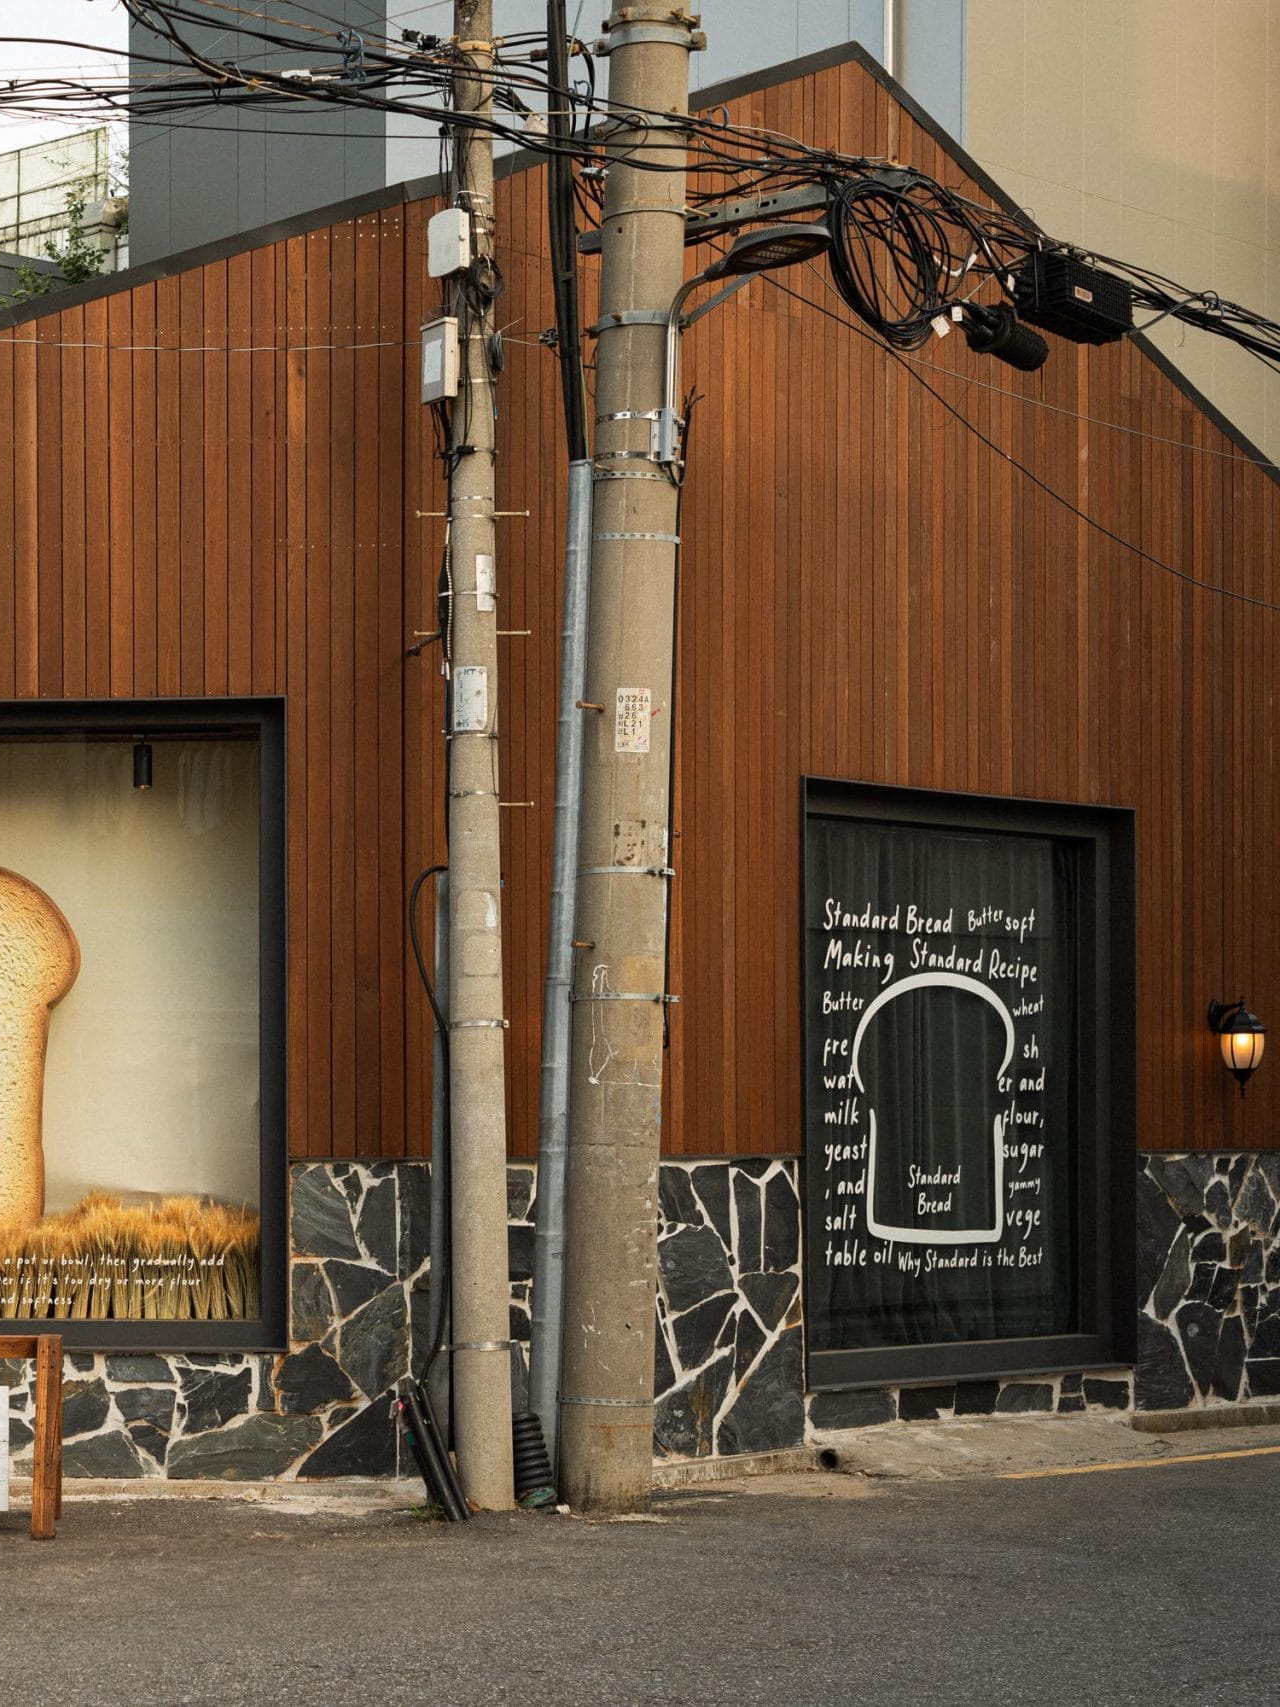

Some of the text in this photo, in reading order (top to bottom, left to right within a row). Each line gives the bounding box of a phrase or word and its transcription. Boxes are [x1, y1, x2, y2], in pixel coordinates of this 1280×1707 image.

[823, 898, 953, 934] Standard Bread
[968, 908, 1035, 943] Butter soft
[824, 938, 1038, 988] Making Standard Recipe
[823, 991, 1044, 1018] Butter wheat
[823, 1035, 1039, 1067] fre sh
[824, 1065, 1044, 1094] wat er and
[824, 1101, 1044, 1136] milk flour,
[824, 1136, 1044, 1173] yeast sugar
[837, 1169, 864, 1196] and
[908, 1164, 961, 1188] Standard
[1009, 1176, 1040, 1198] yammy
[918, 1192, 952, 1215] Bread
[825, 1204, 1041, 1240] salt vege
[17, 1253, 37, 1269] pot
[61, 1253, 93, 1267] bowl,
[100, 1253, 126, 1266] then
[132, 1253, 194, 1272] gradually
[200, 1253, 225, 1266] add
[825, 1239, 893, 1267] table oil
[898, 1246, 1042, 1278] Why Standard is the Best
[20, 1274, 31, 1290] if
[38, 1273, 58, 1285] it's
[64, 1274, 83, 1285] too
[90, 1274, 110, 1290] dry
[135, 1278, 164, 1286] more
[170, 1274, 201, 1290] flour
